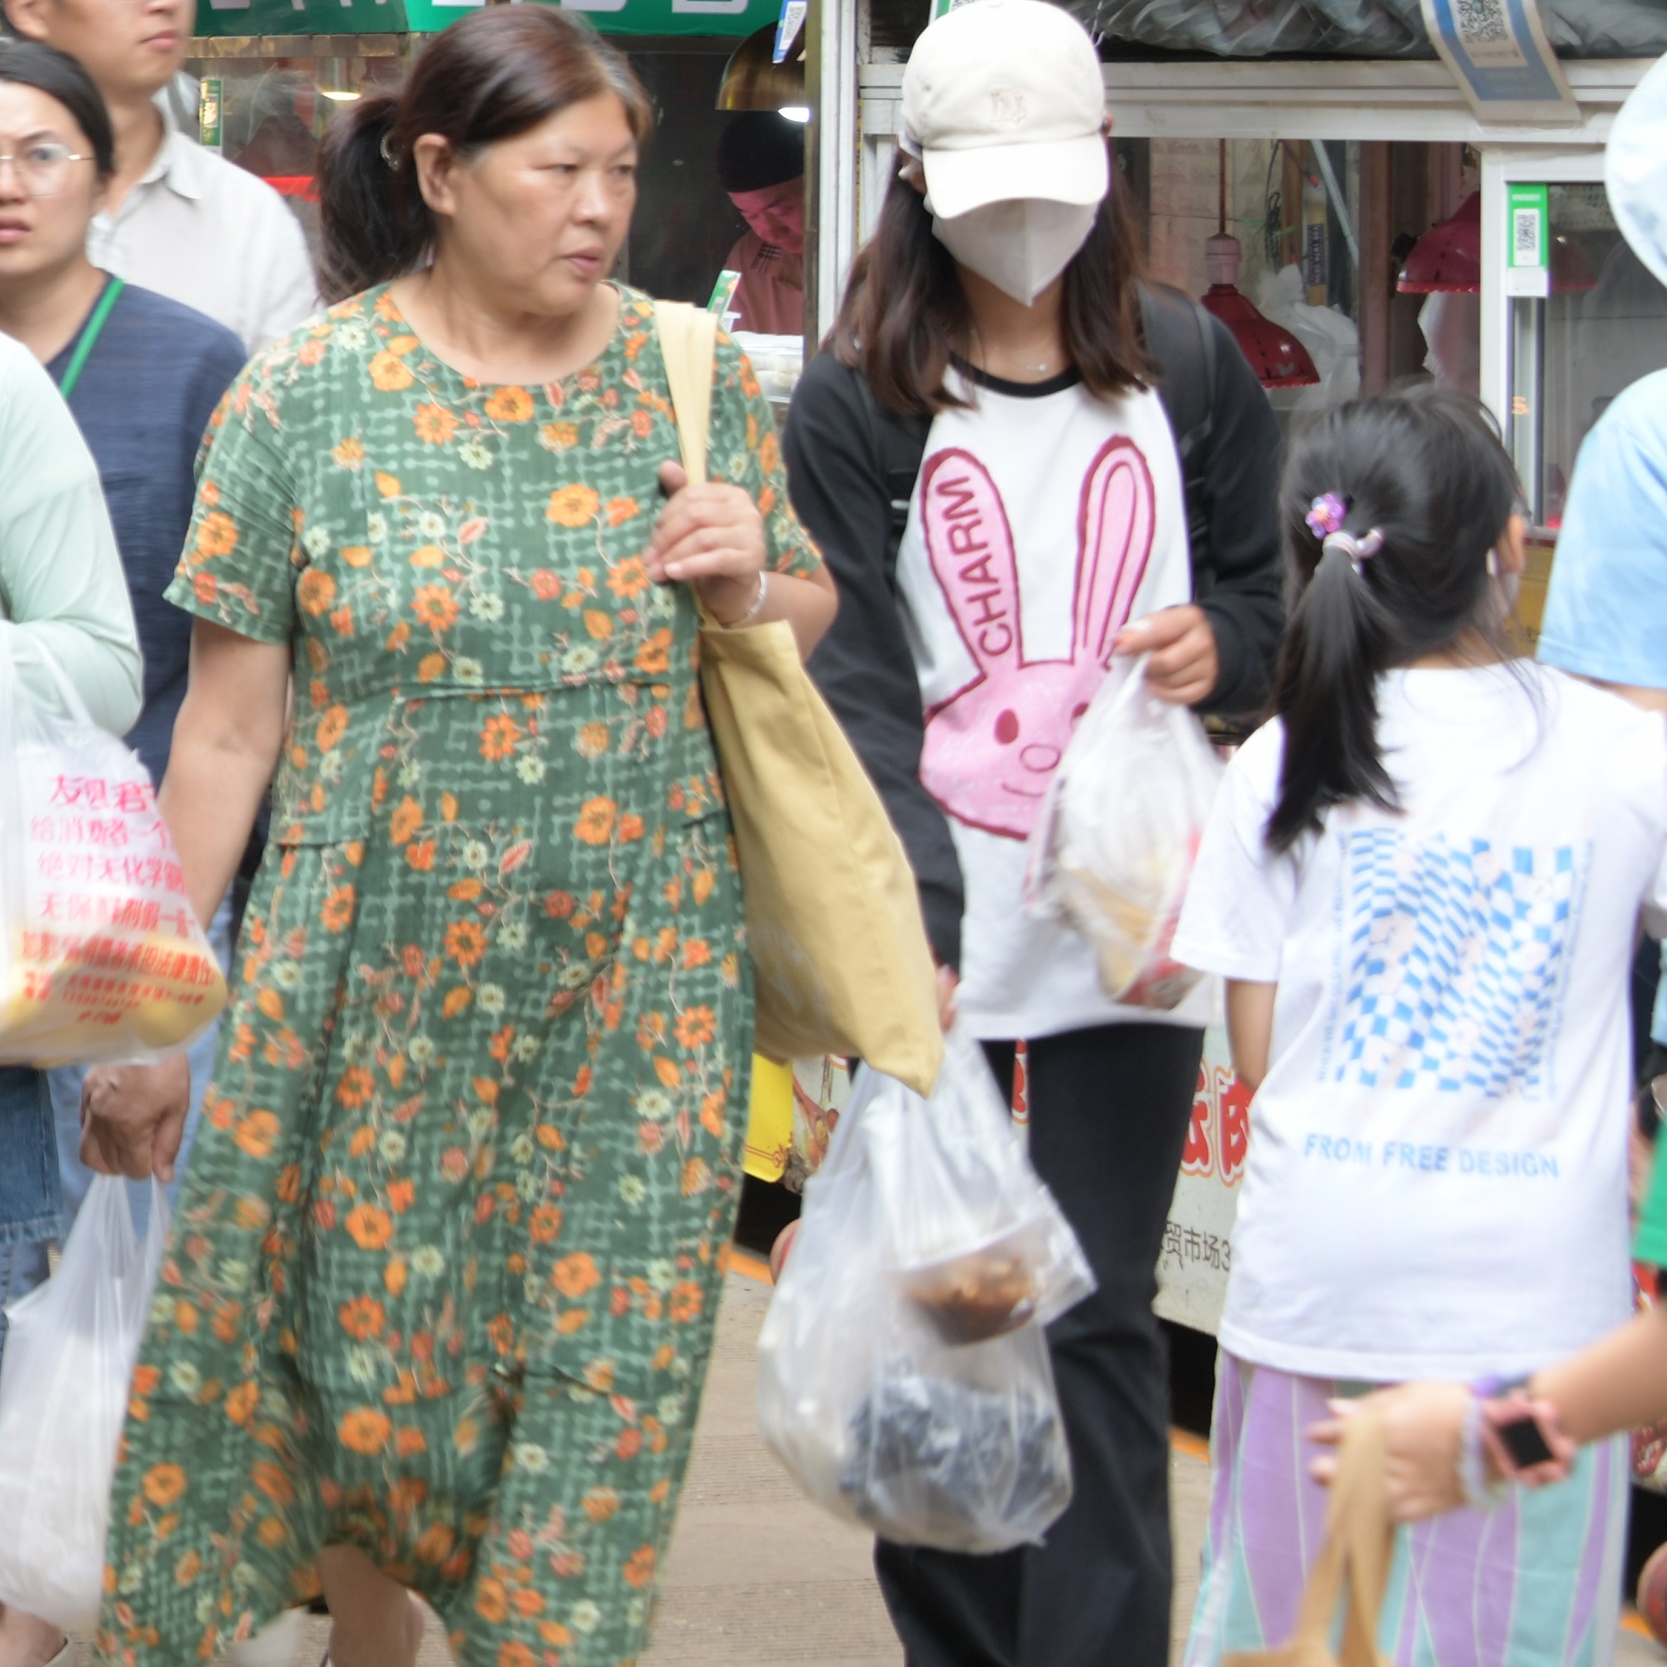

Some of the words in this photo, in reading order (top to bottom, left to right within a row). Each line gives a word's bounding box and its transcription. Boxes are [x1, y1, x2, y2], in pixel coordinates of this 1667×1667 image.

[935, 475, 1014, 659] CHARM
[1305, 1133, 1373, 1165] FROM
[1382, 1141, 1449, 1172] FREE
[1458, 1148, 1561, 1179] DESIGN
